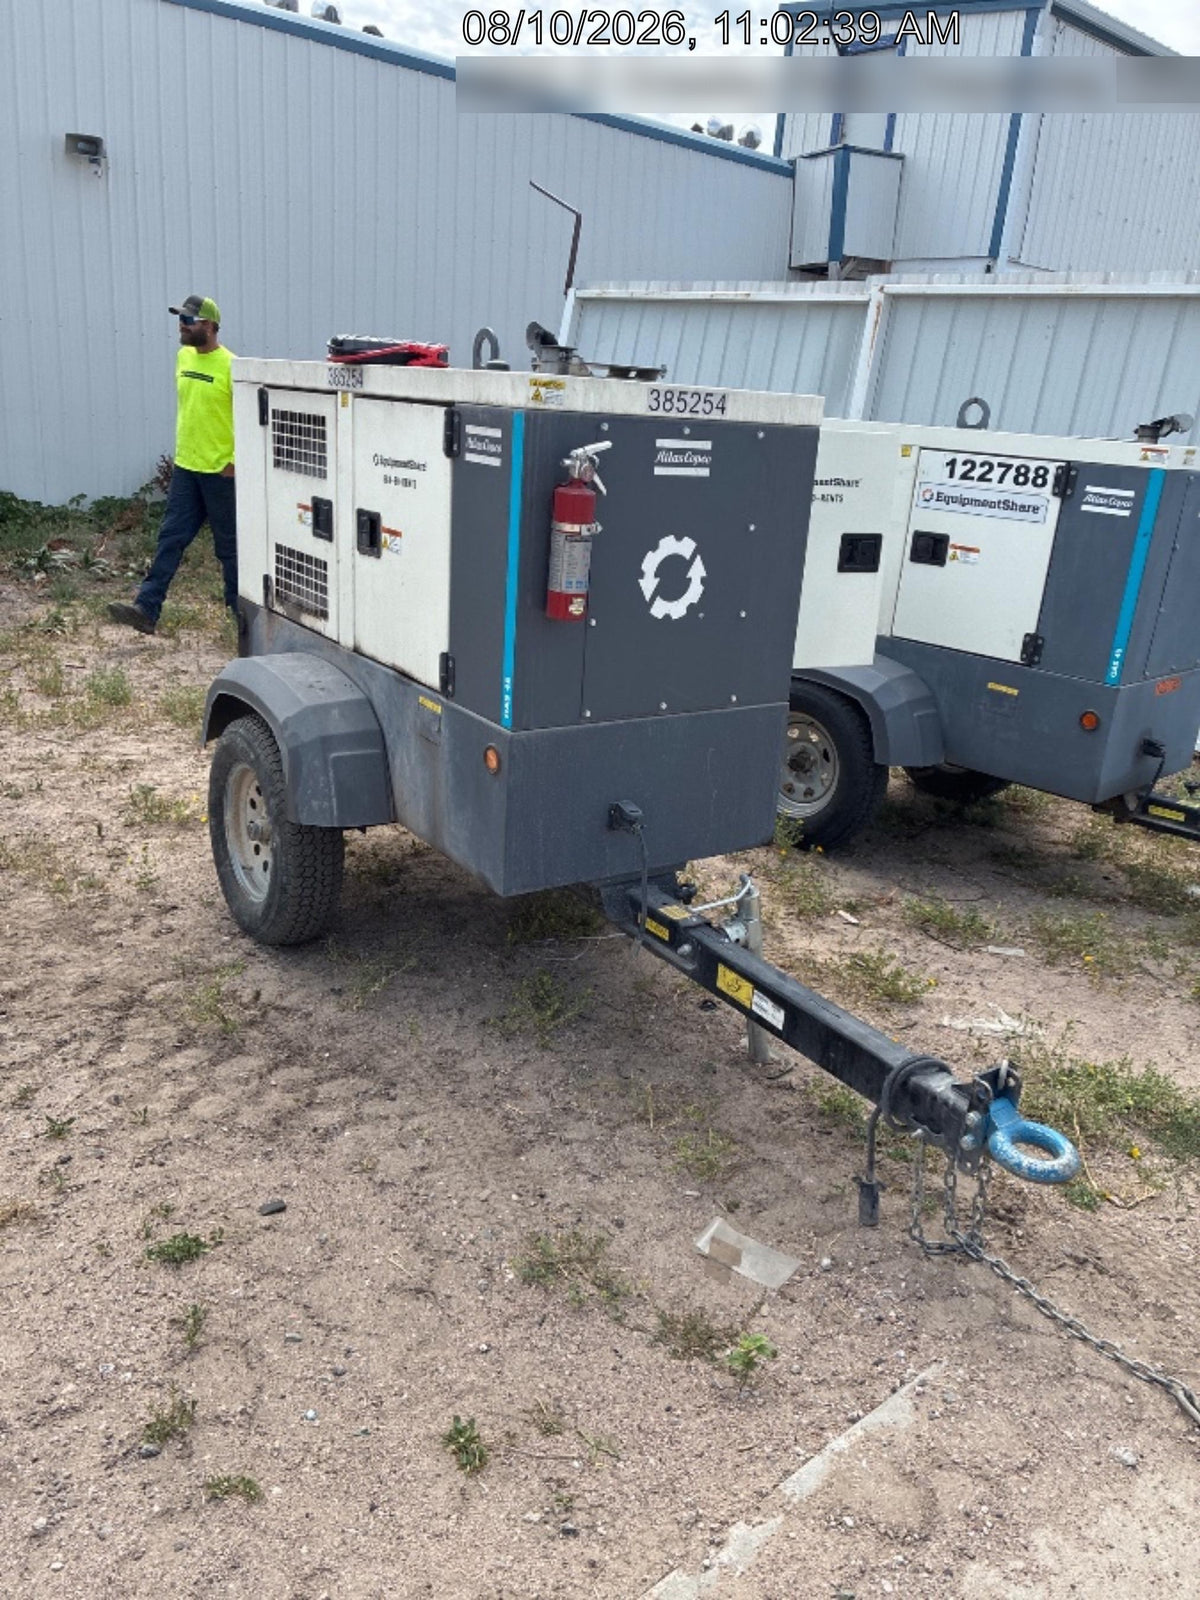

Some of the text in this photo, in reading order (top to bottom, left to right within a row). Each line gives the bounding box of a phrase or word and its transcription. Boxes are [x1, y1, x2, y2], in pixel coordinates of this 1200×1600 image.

[327, 366, 363, 388] 385254
[648, 388, 727, 415] 385254
[945, 457, 1050, 488] 122788
[935, 491, 1040, 515] EquipmentShare
